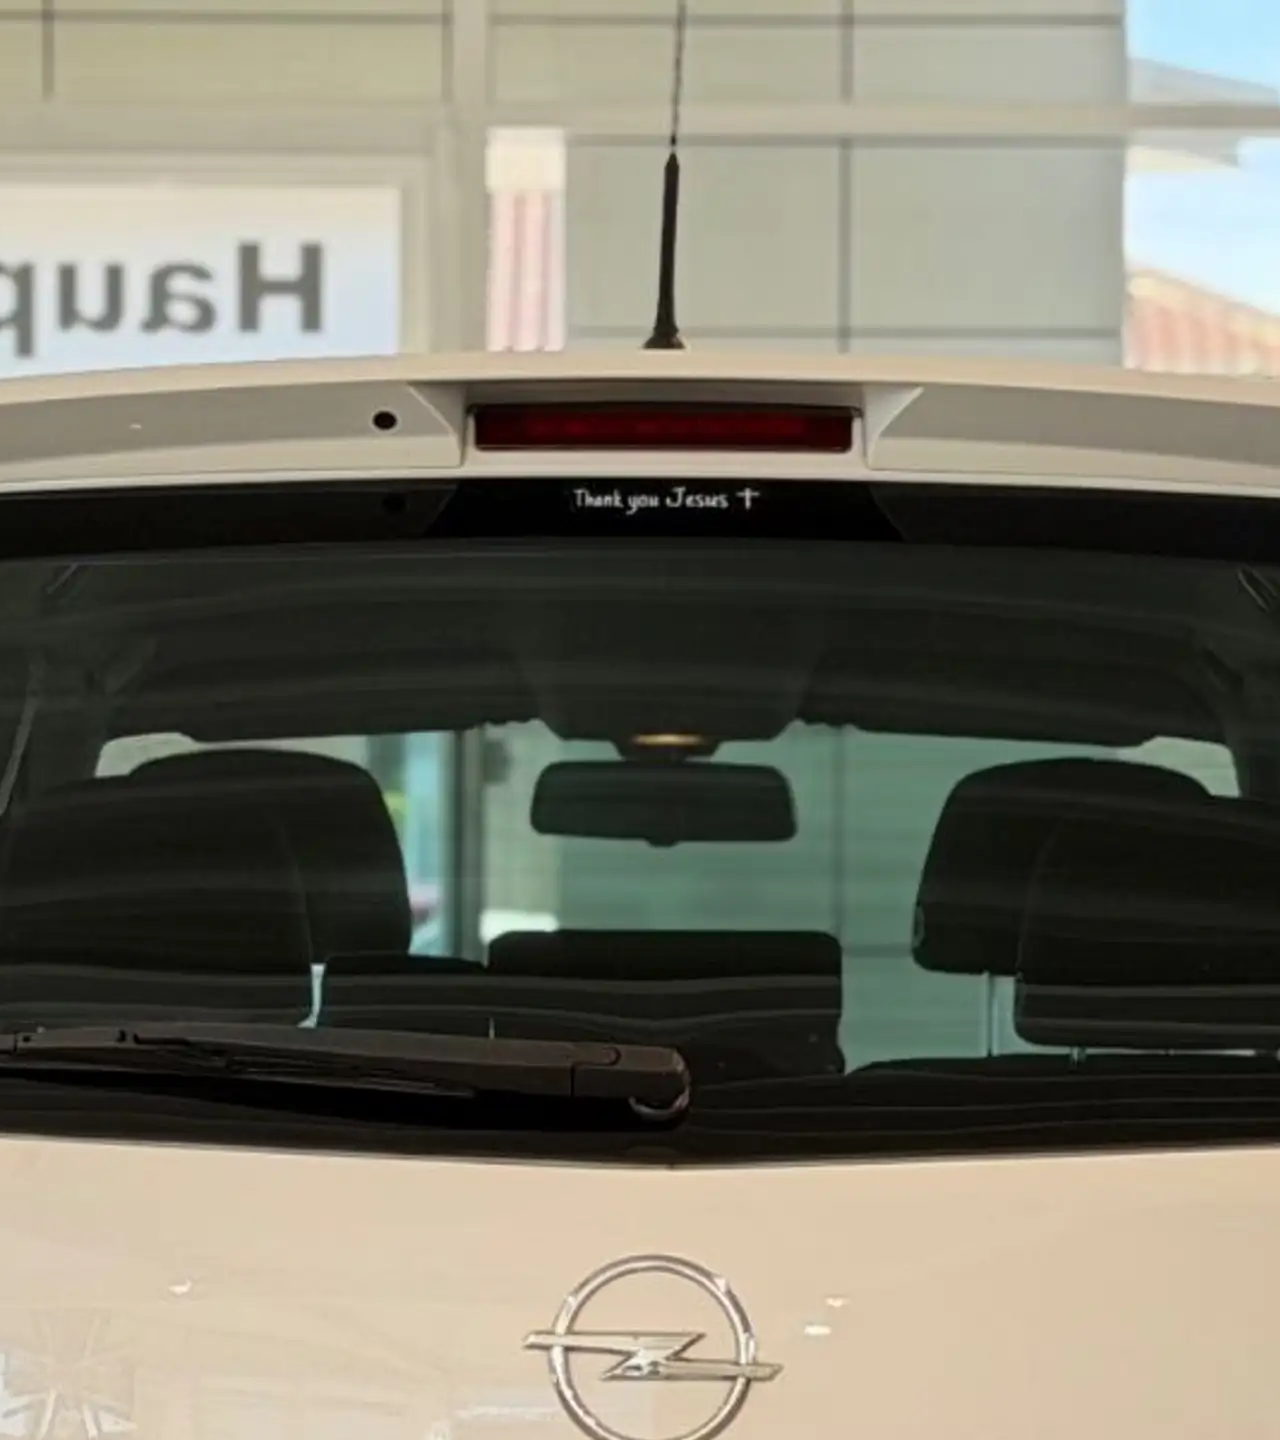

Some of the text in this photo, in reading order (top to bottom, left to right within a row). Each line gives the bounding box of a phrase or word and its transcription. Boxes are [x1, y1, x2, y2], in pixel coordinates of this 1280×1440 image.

[573, 486, 729, 516] Thank you Jesus
